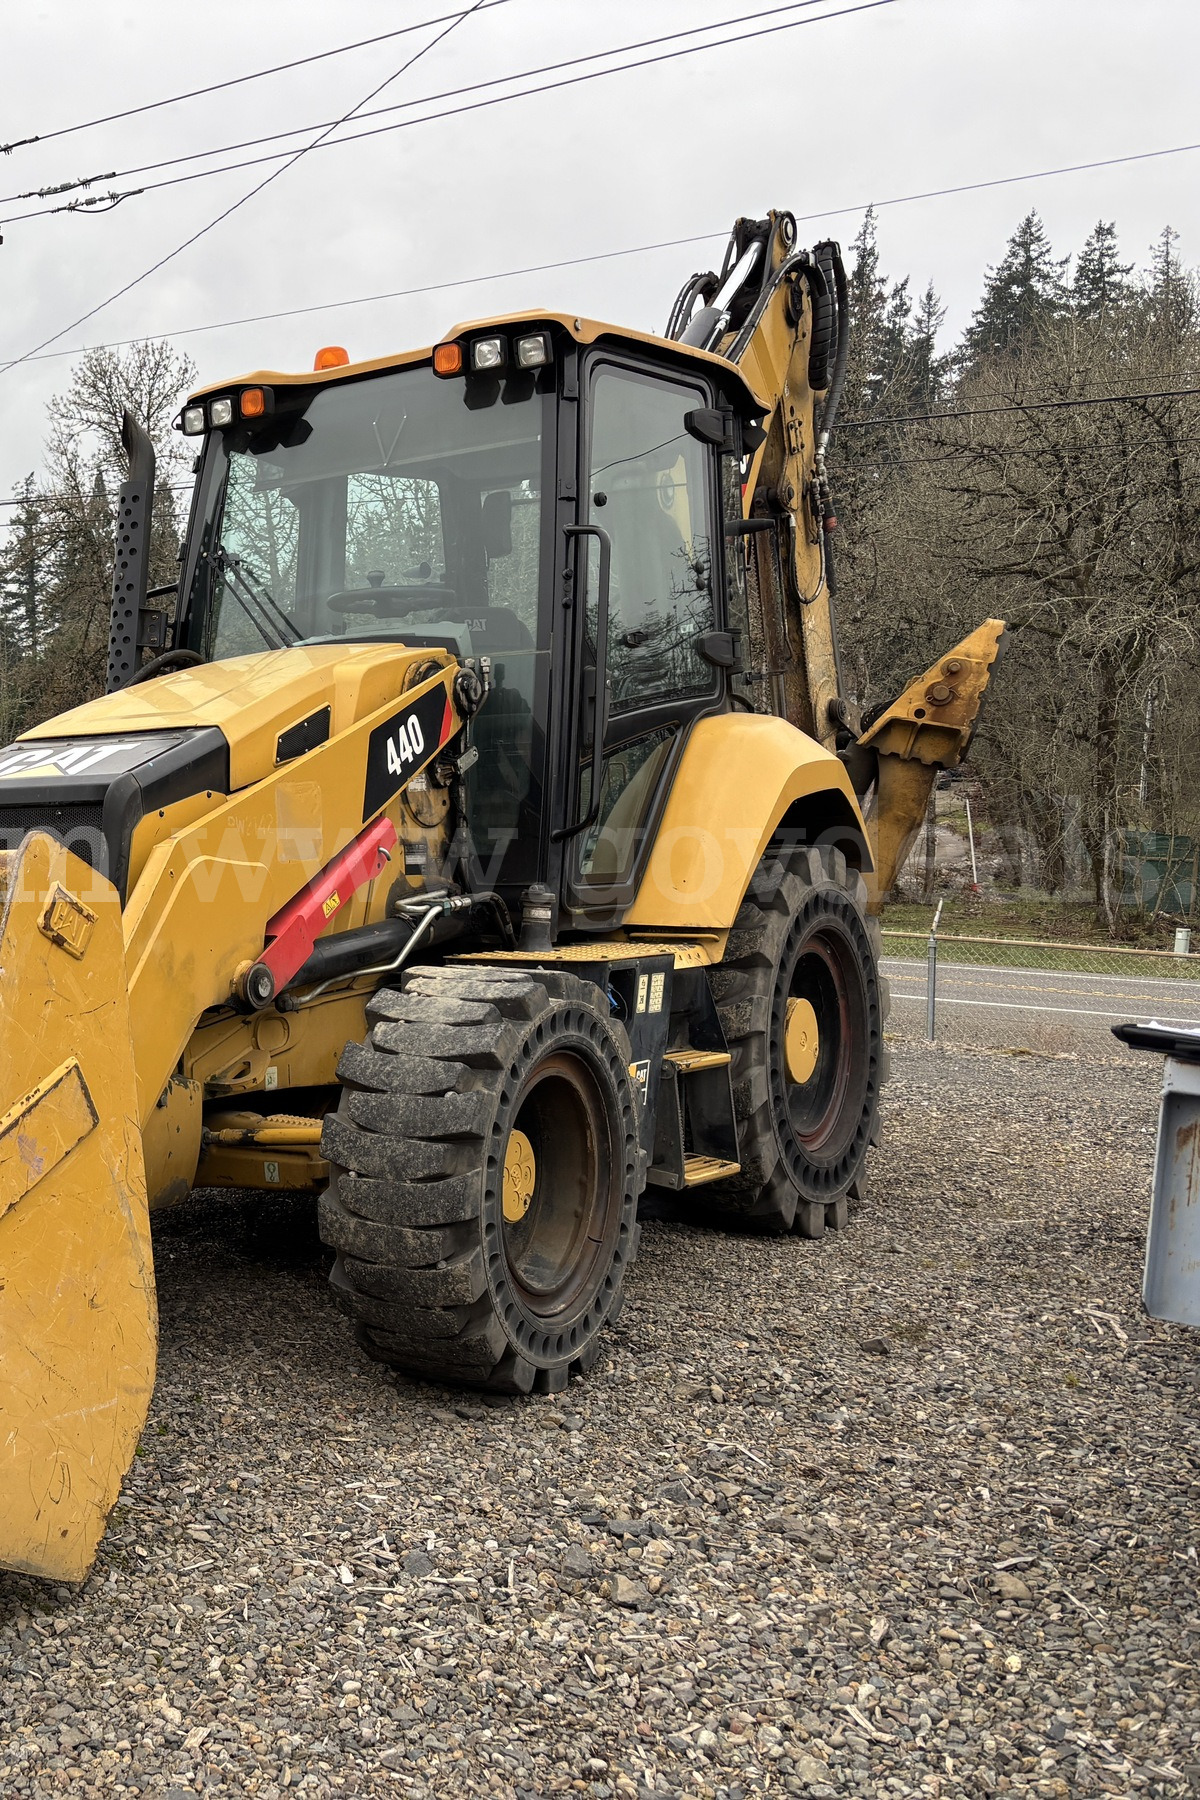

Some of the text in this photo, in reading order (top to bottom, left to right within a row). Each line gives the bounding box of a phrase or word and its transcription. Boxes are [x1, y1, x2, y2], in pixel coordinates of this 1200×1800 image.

[464, 619, 488, 631] CAT
[386, 714, 425, 776] 440
[49, 897, 92, 951] CAT
